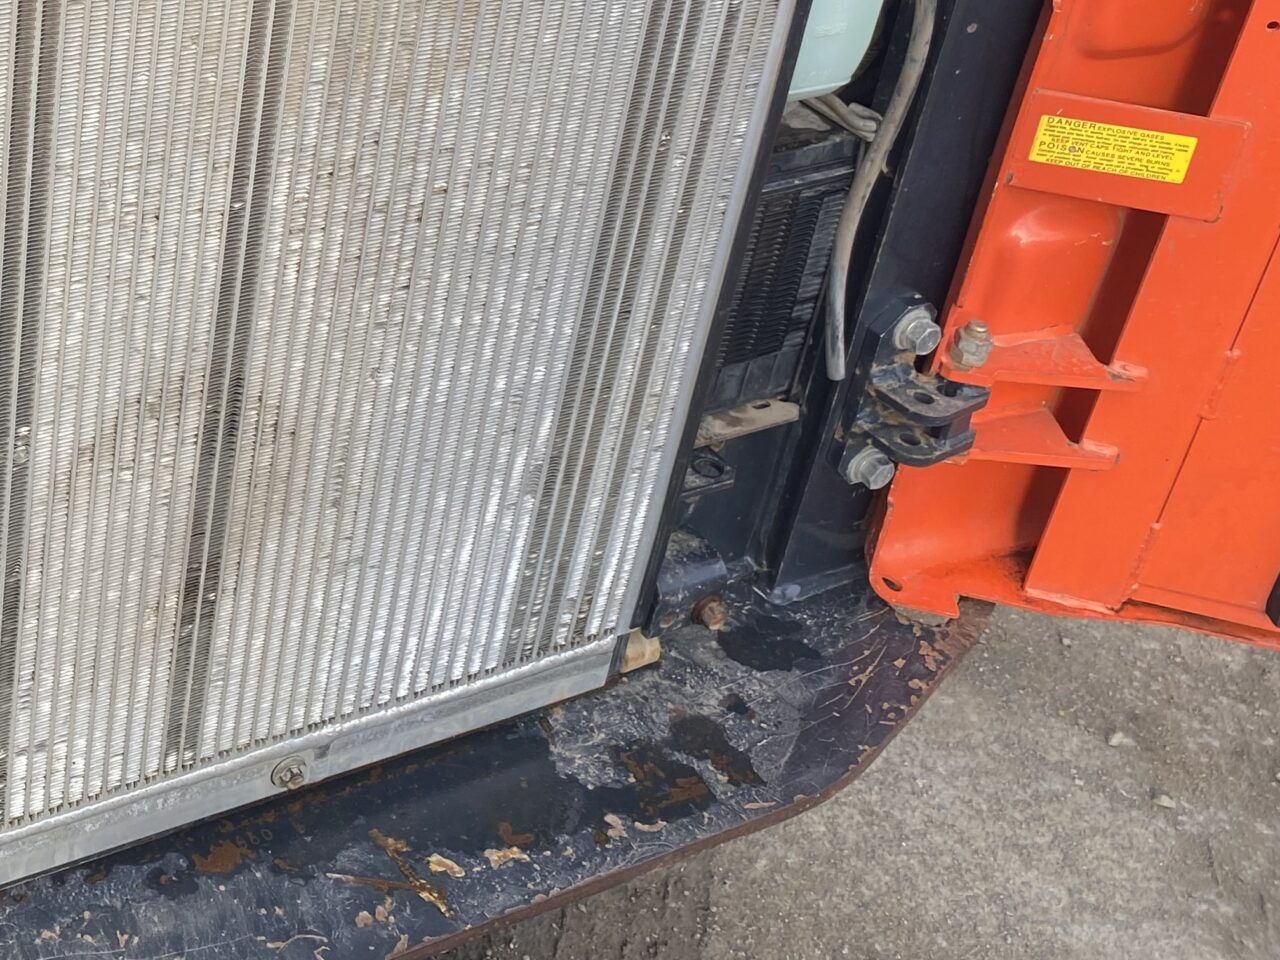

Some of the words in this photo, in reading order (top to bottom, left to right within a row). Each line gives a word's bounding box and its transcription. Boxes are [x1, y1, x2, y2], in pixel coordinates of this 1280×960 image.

[1046, 117, 1097, 129] DANGER
[1097, 126, 1138, 136] EXPLOSIVE
[1038, 141, 1085, 153] POISN
[1085, 150, 1115, 158] CAUSES
[1145, 159, 1170, 167] BURNS
[1129, 171, 1166, 180] CHILDREN
